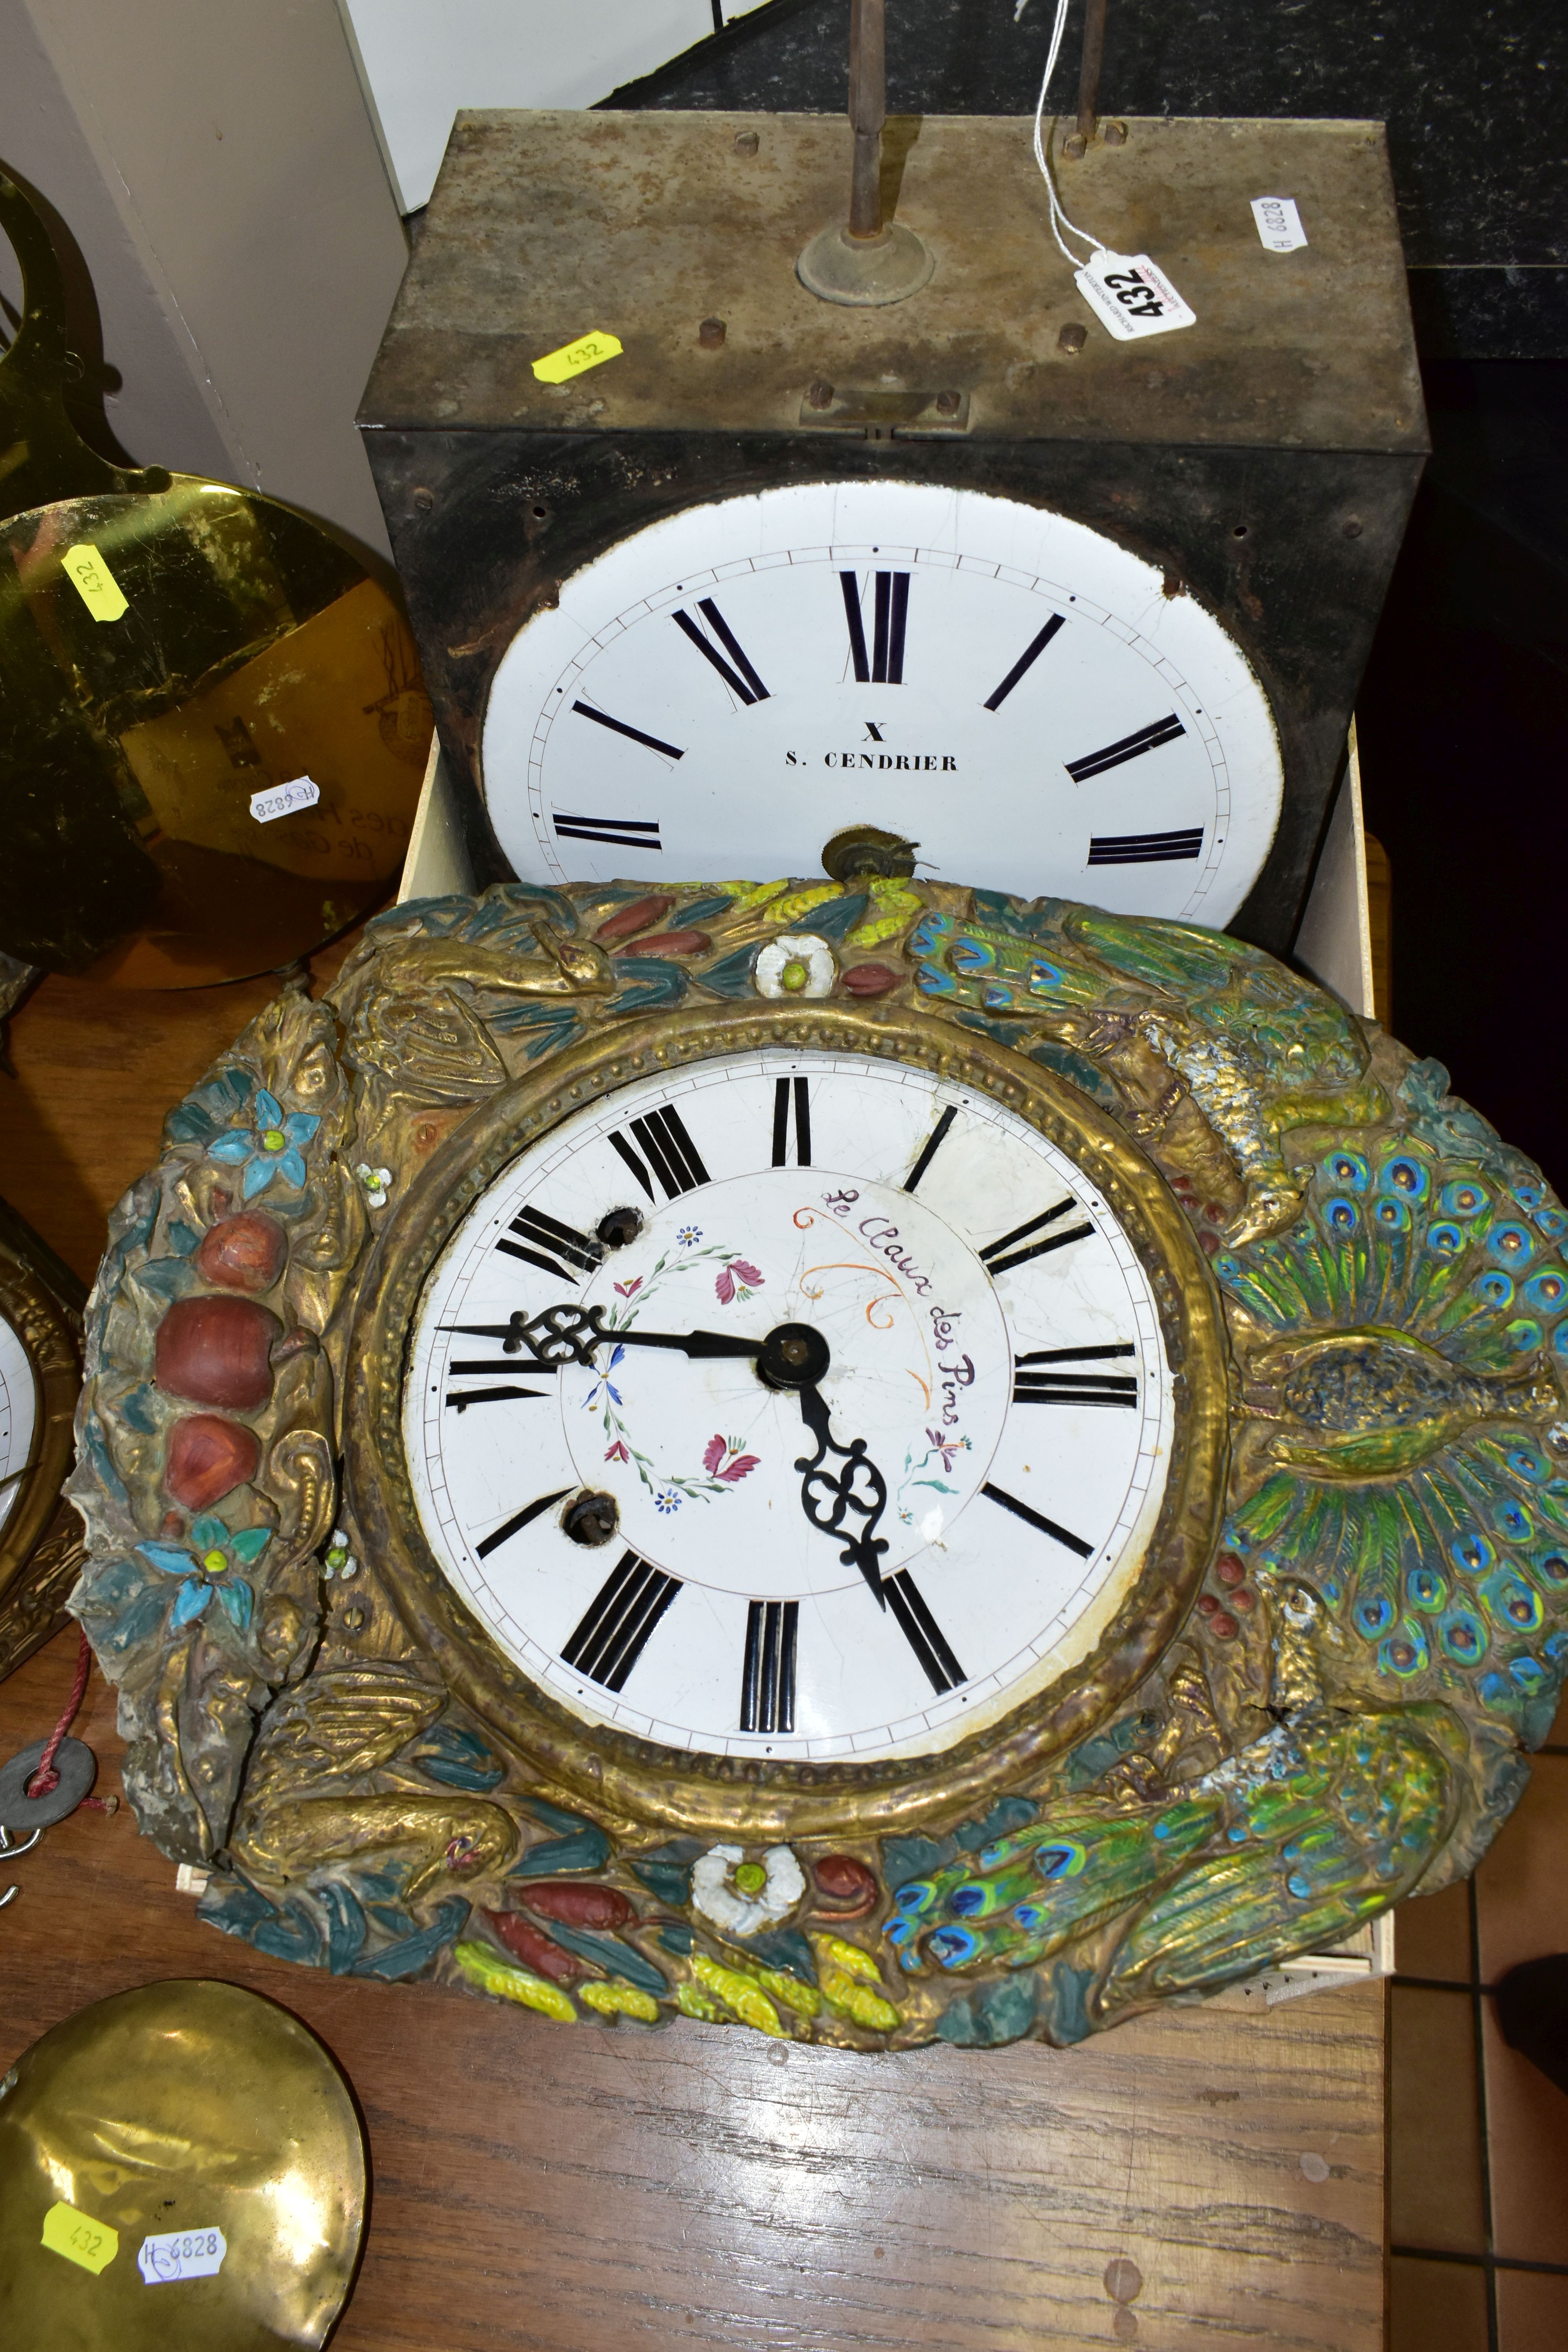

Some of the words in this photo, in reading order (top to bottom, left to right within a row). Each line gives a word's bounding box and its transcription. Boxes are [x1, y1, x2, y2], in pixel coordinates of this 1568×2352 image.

[1261, 202, 1287, 232] 6828
[1083, 271, 1111, 307] WINTERTON
[1103, 269, 1164, 317] 432
[1110, 303, 1134, 332] RICHARD
[567, 343, 604, 365] 432
[76, 561, 103, 592] 432
[861, 722, 887, 742] X
[786, 750, 807, 766] S.
[824, 752, 959, 771] CENDRIER
[256, 794, 293, 817] 6828
[303, 786, 314, 800] H
[821, 1189, 860, 1217] Le
[858, 1217, 933, 1297] Claux
[929, 1306, 962, 1351] des
[938, 1353, 975, 1426] Pins
[69, 2226, 103, 2257] 432
[145, 2243, 155, 2264] H
[170, 2233, 218, 2259] 6828
